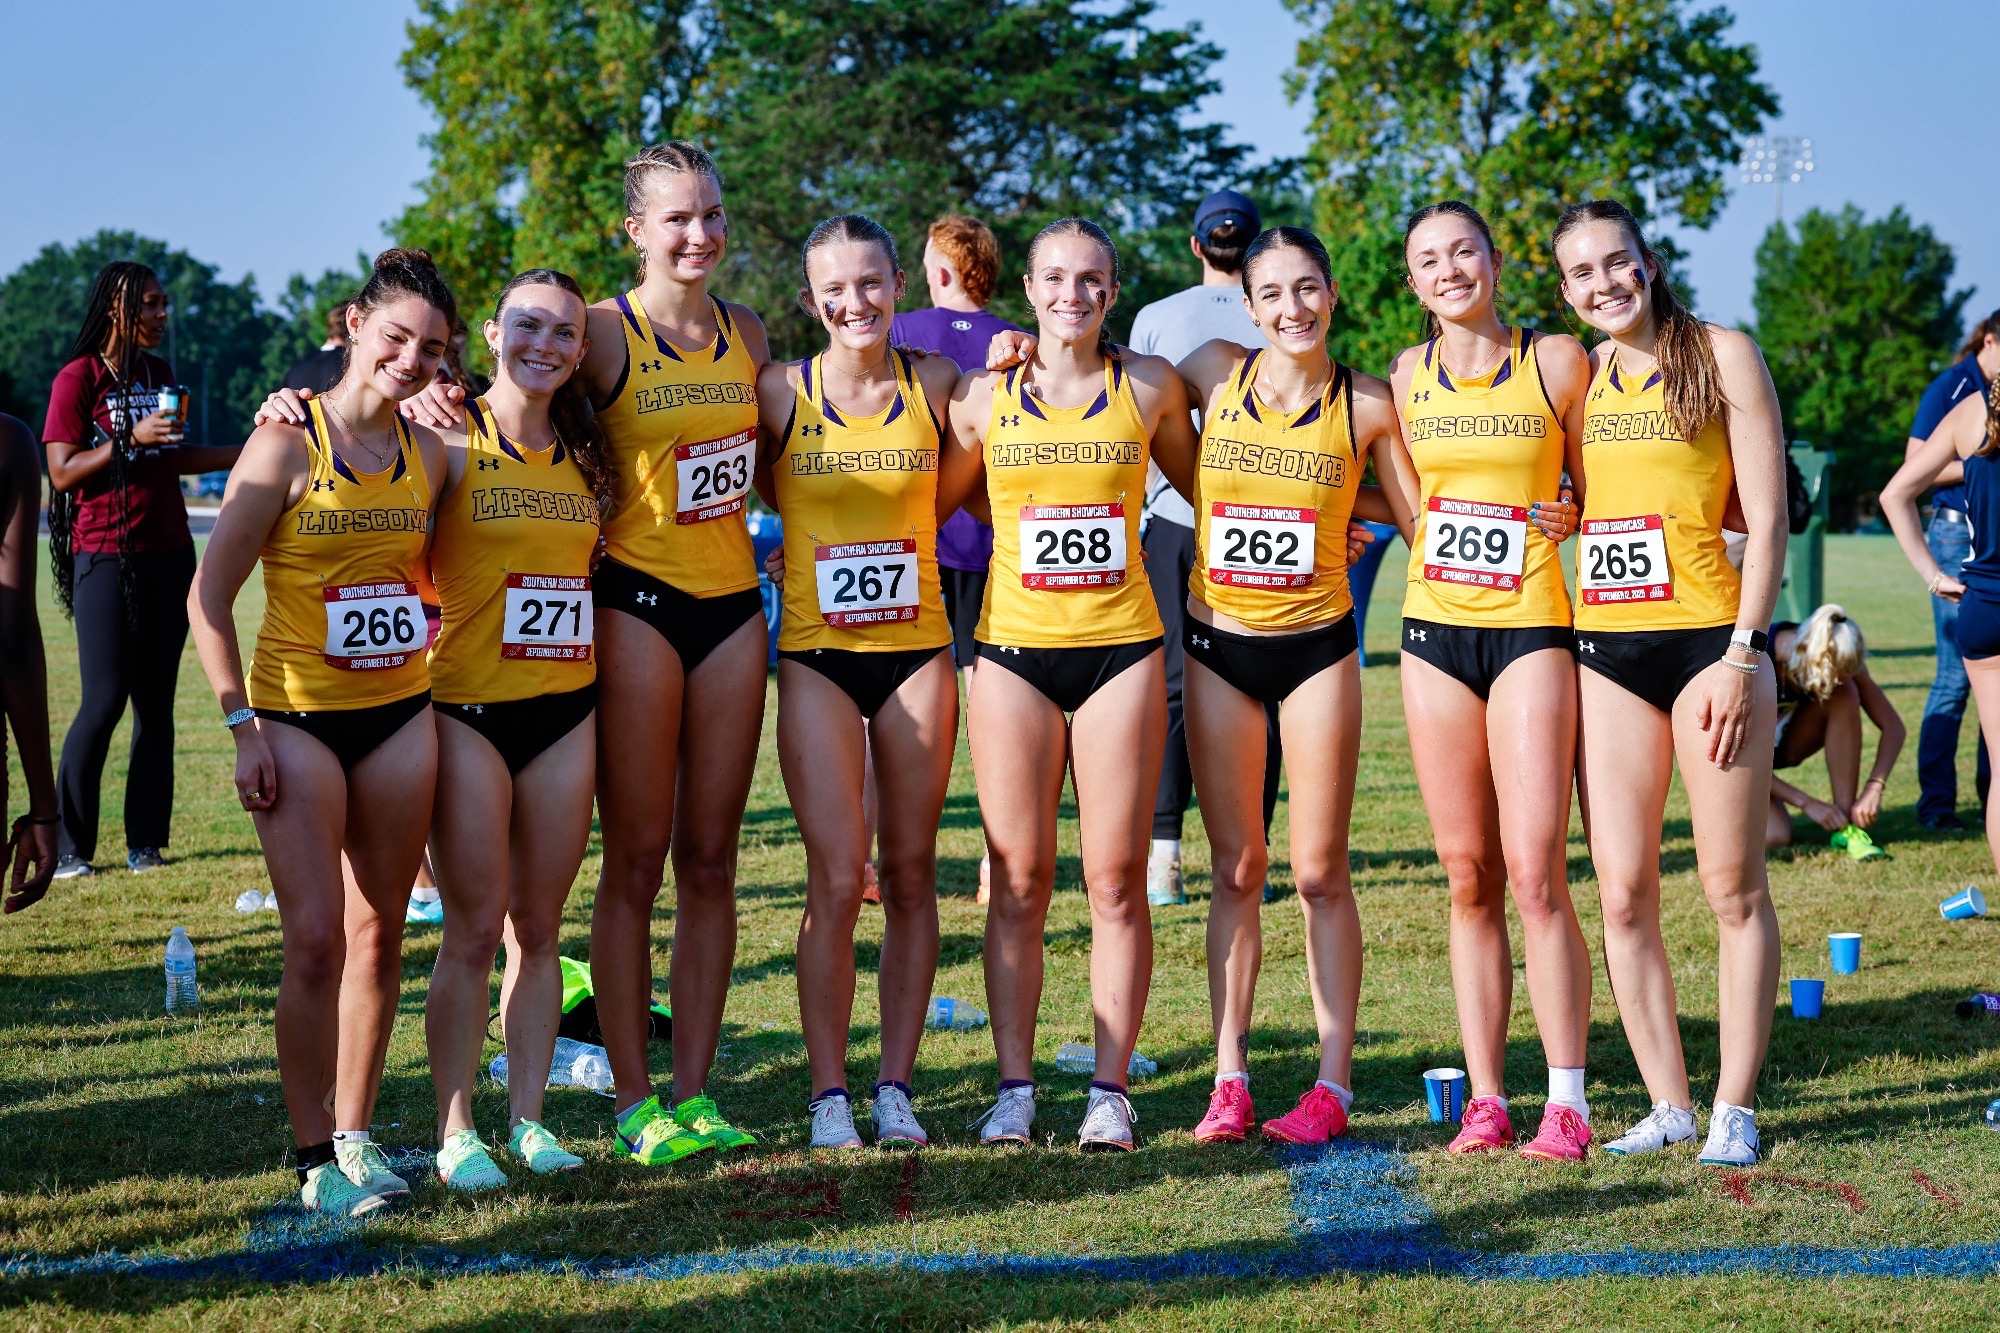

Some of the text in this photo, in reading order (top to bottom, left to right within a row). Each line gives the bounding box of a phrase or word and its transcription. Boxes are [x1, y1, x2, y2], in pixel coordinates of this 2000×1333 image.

[636, 383, 758, 414] LIPSCOM
[689, 441, 720, 457] SOUTHERN
[993, 442, 1142, 467] LIPSCOMB
[791, 449, 938, 476] LIPSCOMB
[1201, 437, 1345, 488] LIPSCOMB
[691, 454, 747, 501] 263
[1034, 506, 1111, 519] SOUTHERN SHOWCASE
[1225, 506, 1301, 521] SOUTHERN SHOWCASE
[1440, 500, 1513, 518] SOUTHERN SHOWCASE
[1610, 518, 1646, 532] SHOWCASE
[829, 542, 904, 558] SOUTHERN SHOWCASE
[1035, 527, 1112, 565] 268
[1223, 527, 1299, 566] 262
[1436, 523, 1509, 564] 269
[1589, 541, 1651, 580] 265
[522, 576, 557, 588] SOUTHERN
[832, 563, 906, 603] 267
[1045, 575, 1080, 585] SEPTEMBER
[1231, 574, 1264, 584] SEPTEMBER
[1441, 570, 1470, 581] SEPTEMBER
[339, 583, 407, 599] SOUTHERN SHOWCASE
[1598, 590, 1625, 601] SEPTEMBER
[343, 605, 415, 649] 266
[519, 599, 582, 636] 271
[844, 612, 877, 623] SEPTEMBER
[1442, 1082, 1451, 1123] POWERADE
